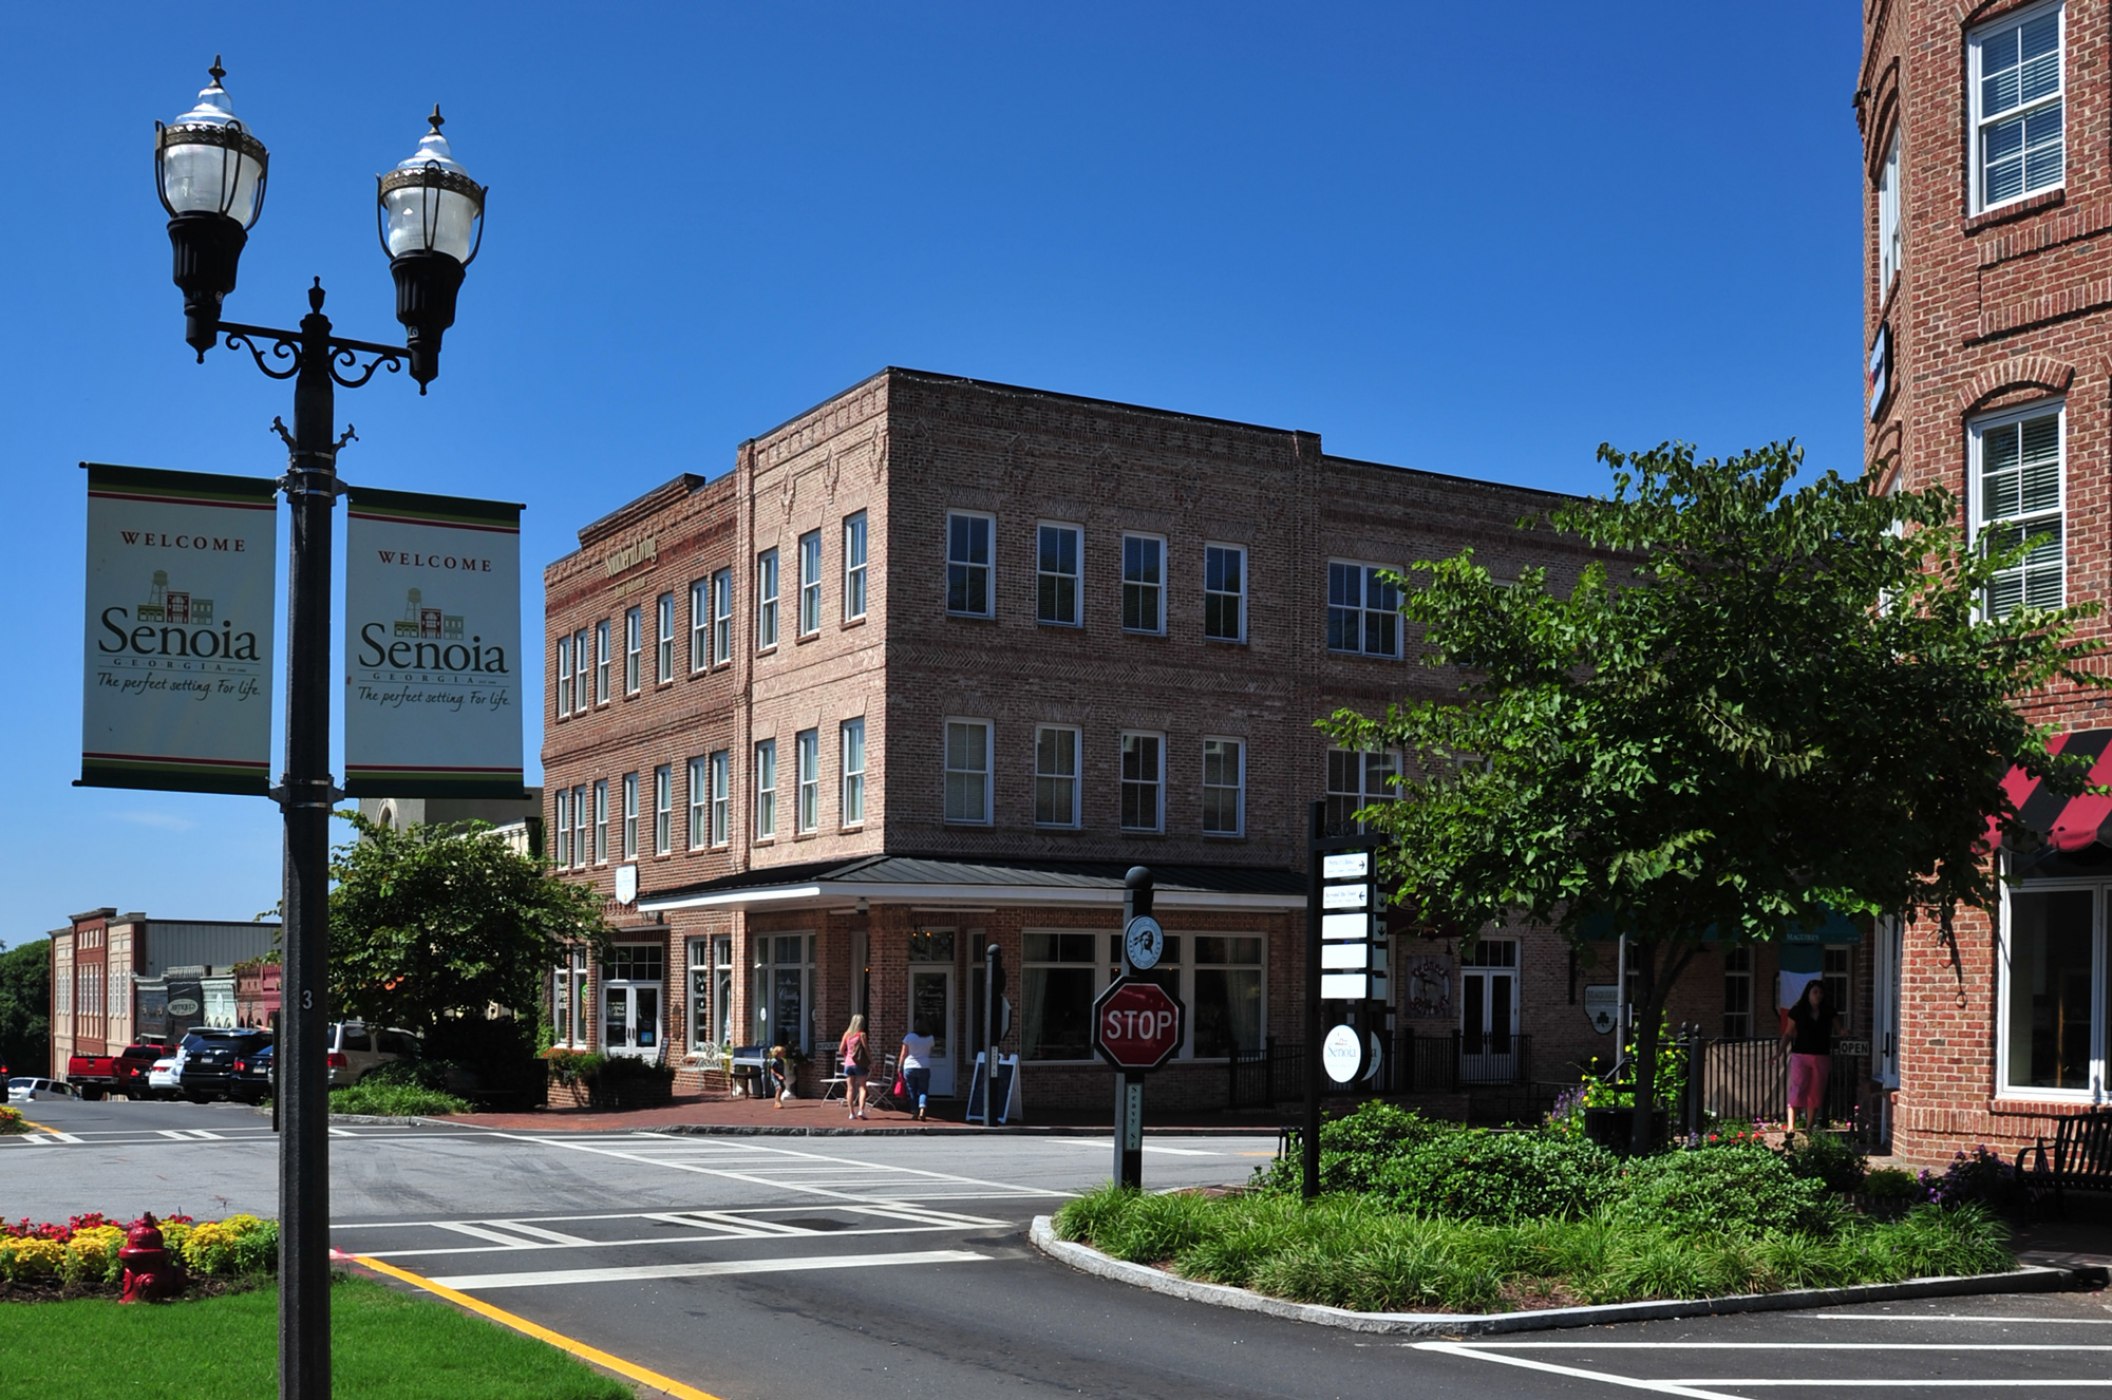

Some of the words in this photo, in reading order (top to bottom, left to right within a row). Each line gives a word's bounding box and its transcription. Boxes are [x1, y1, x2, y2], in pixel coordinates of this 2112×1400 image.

[120, 530, 247, 553] WELCOME
[377, 550, 493, 572] WELCOME
[98, 606, 261, 662] Senoia
[358, 622, 508, 674] Senoia
[97, 672, 120, 687] The
[121, 671, 168, 696] perfect
[218, 679, 236, 695] For
[238, 677, 261, 702] life.
[358, 686, 379, 701] The
[380, 685, 424, 709] perfect
[470, 690, 488, 705] For
[489, 688, 511, 712] life.
[303, 990, 313, 1010] 3
[1106, 1010, 1173, 1040] STOP
[1327, 1044, 1357, 1058] Senoia
[1841, 1042, 1869, 1054] OPEN
